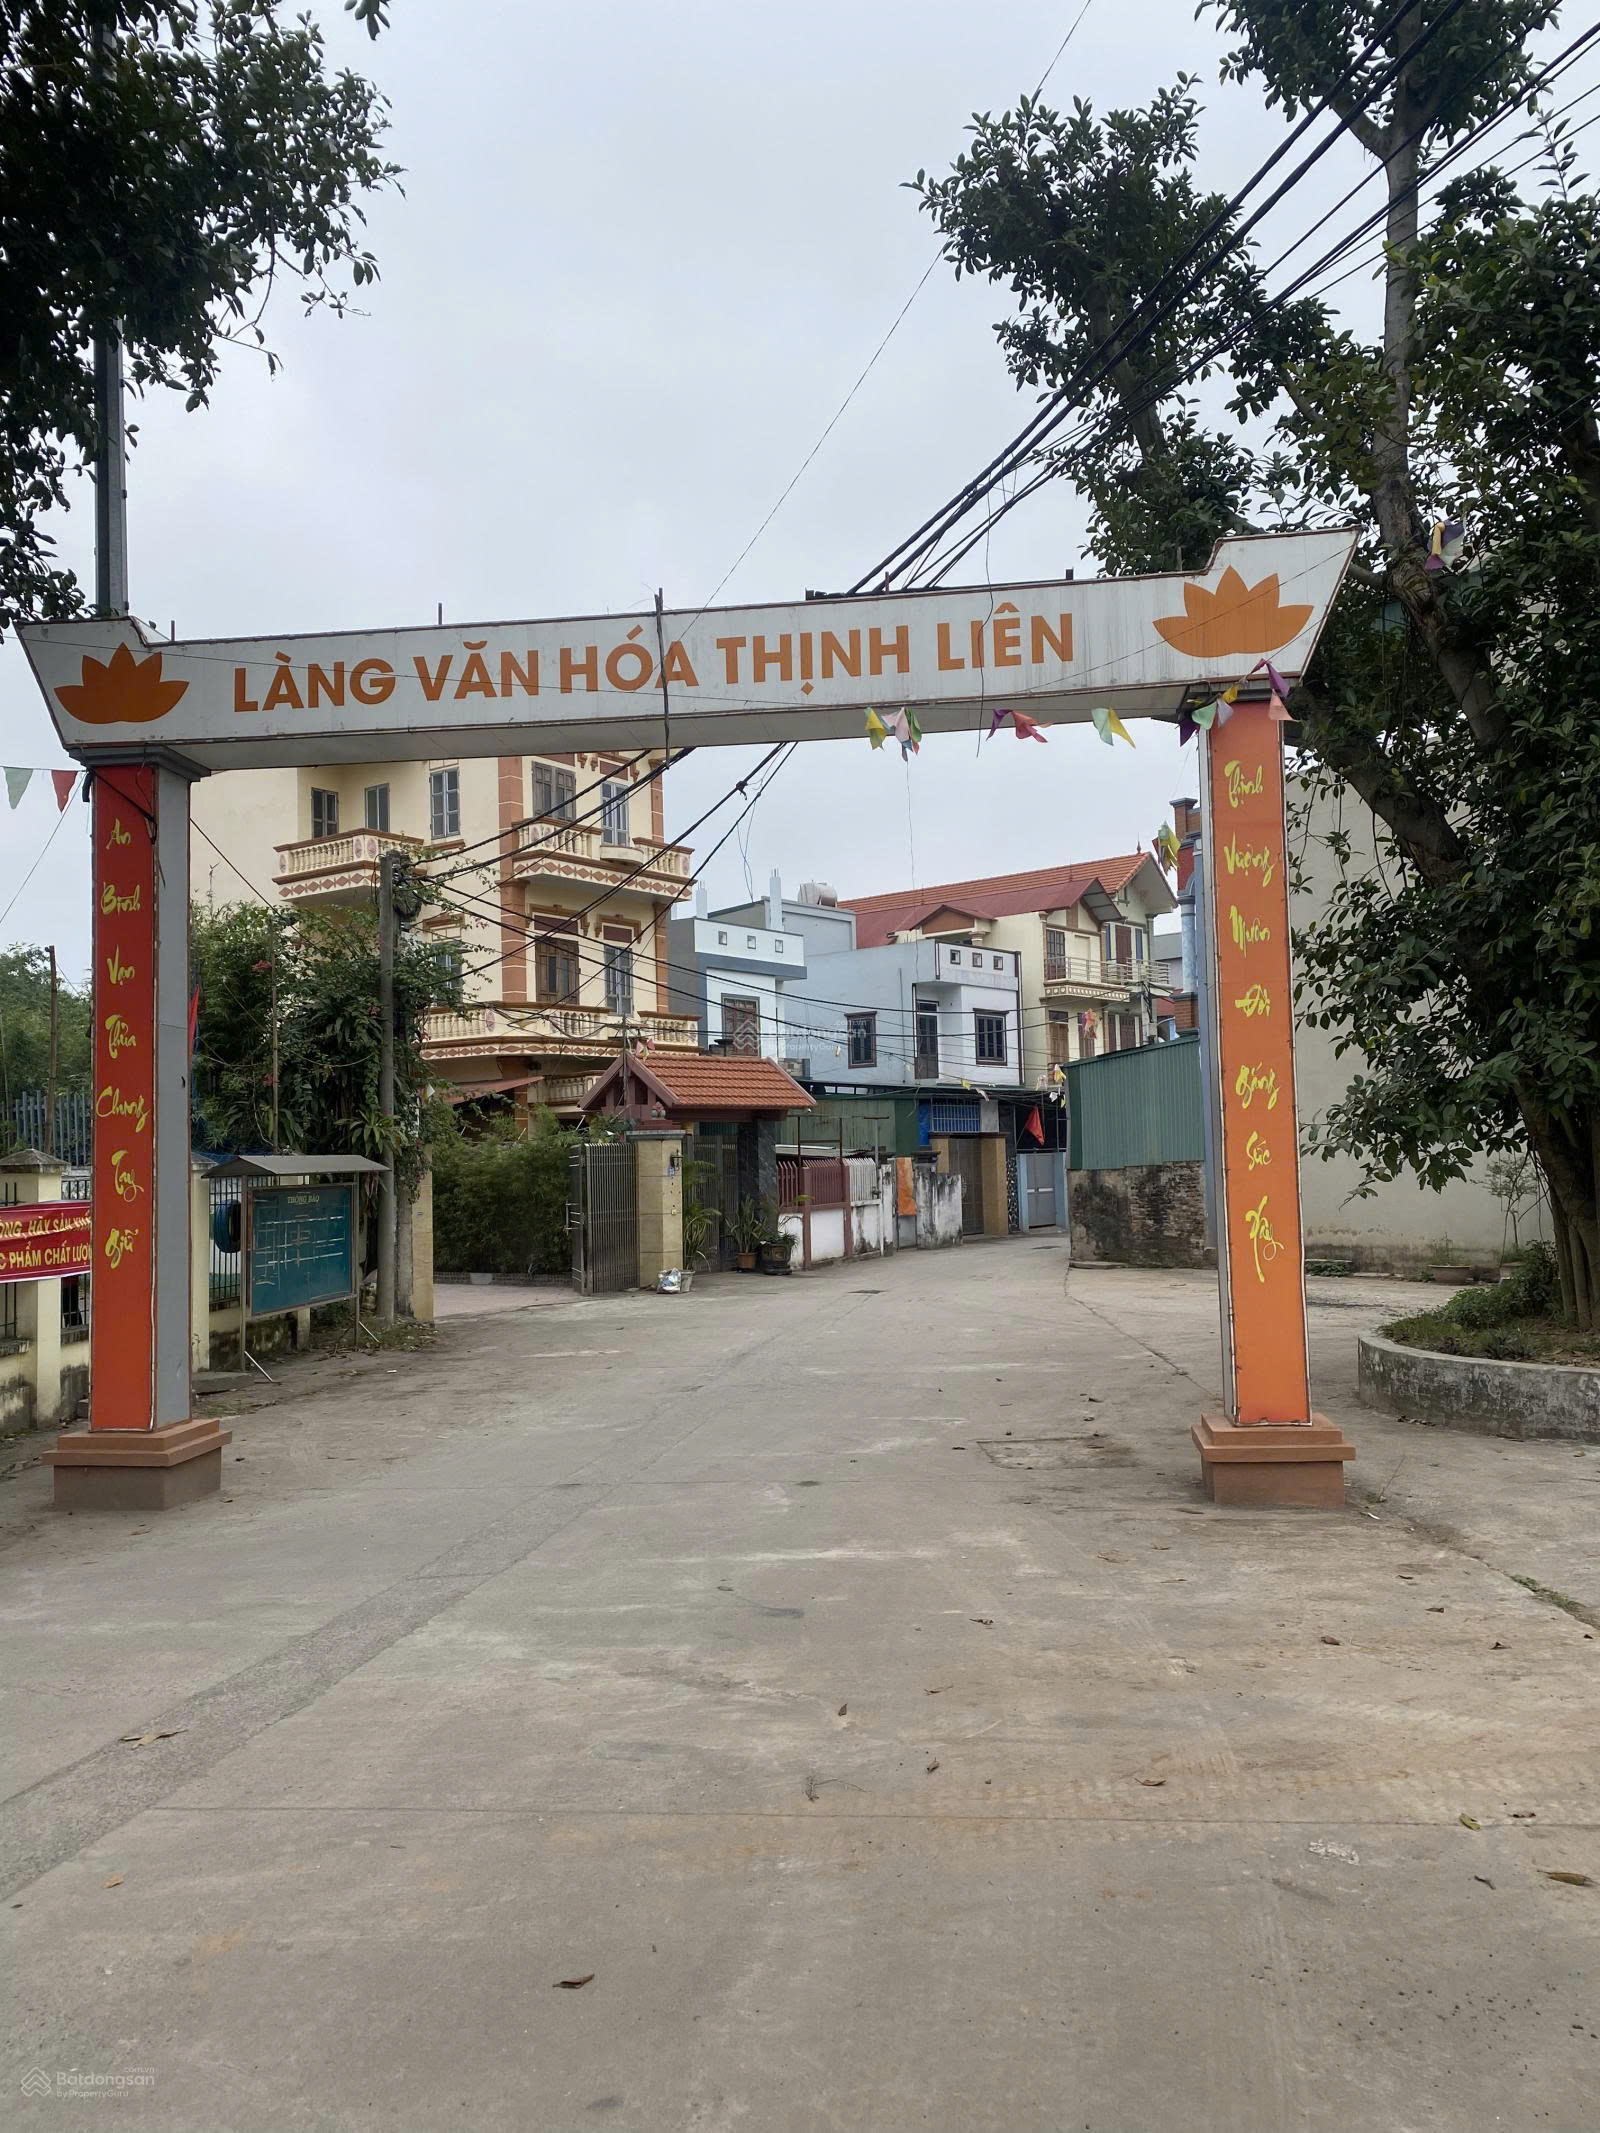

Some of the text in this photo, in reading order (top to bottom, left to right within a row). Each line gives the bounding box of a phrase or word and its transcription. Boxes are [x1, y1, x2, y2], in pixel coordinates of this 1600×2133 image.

[234, 602, 1074, 712] LÀNG VĂN HÓA THỊNH LIÊN
[111, 1150, 145, 1202] Tay
[9, 1241, 42, 1269] PHẨM
[45, 1240, 71, 1265] CHẤT
